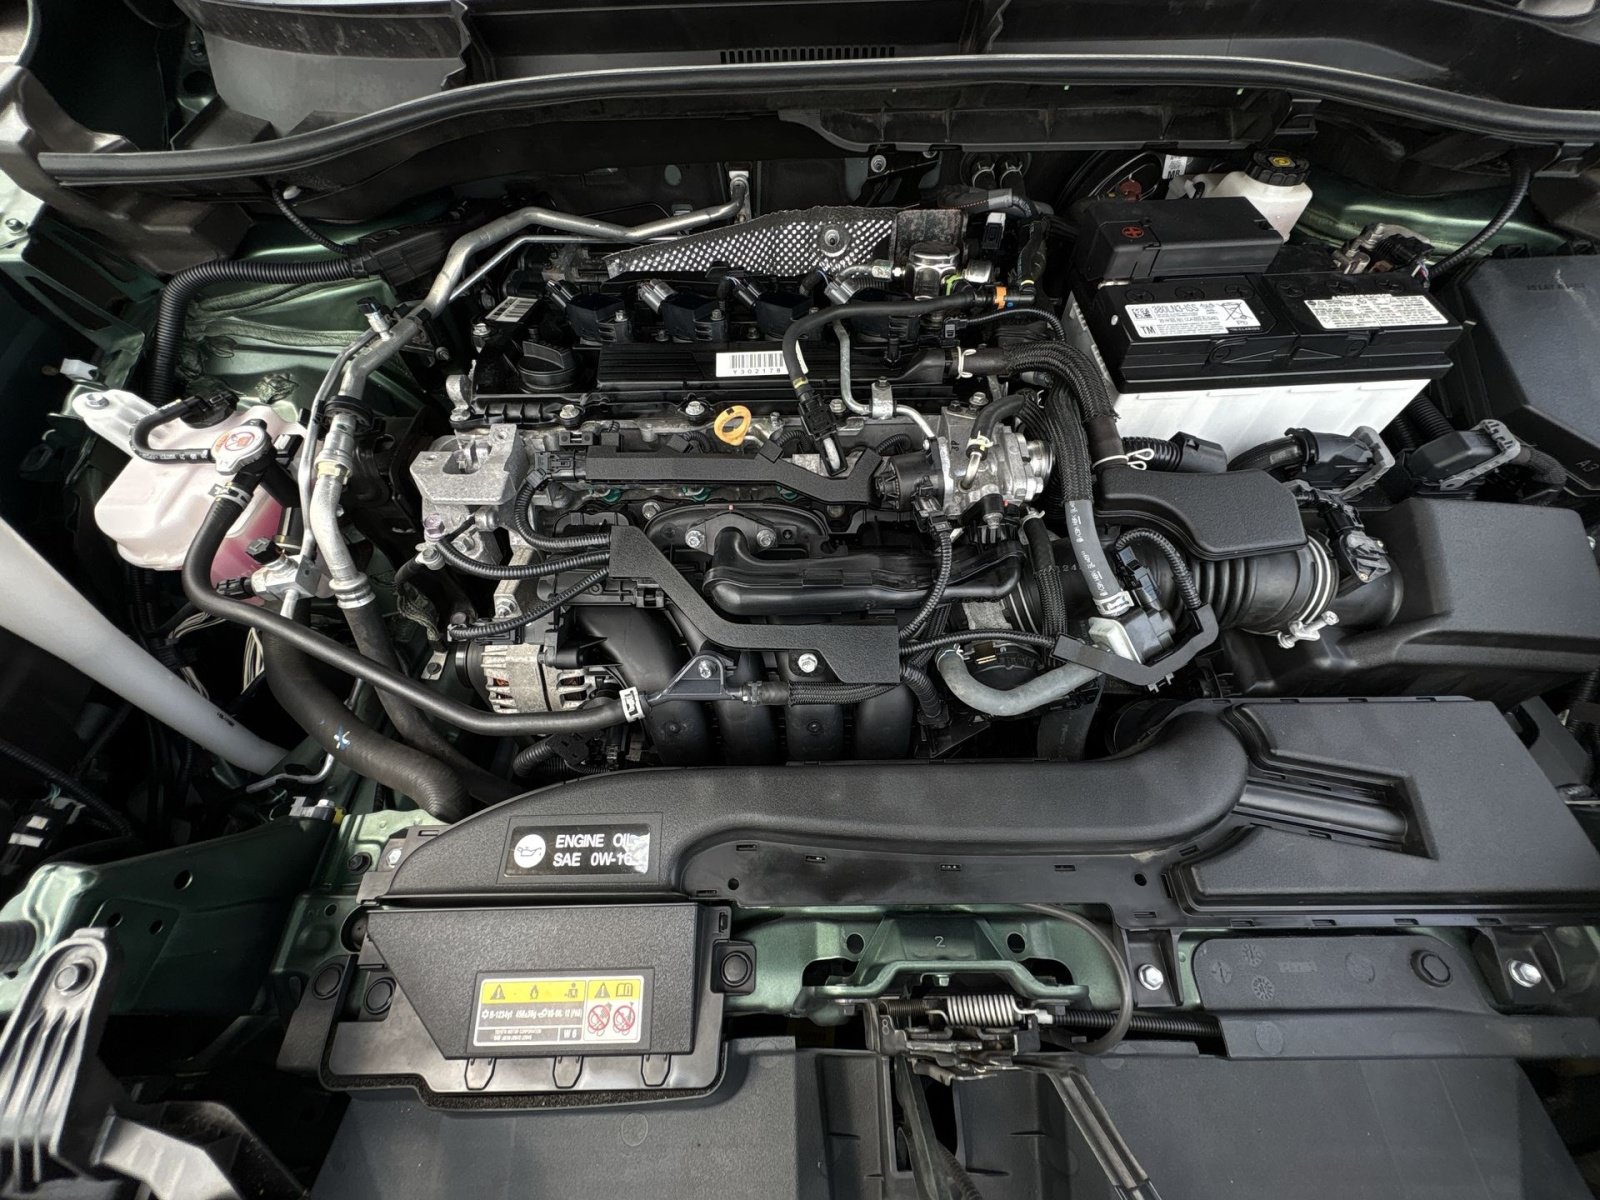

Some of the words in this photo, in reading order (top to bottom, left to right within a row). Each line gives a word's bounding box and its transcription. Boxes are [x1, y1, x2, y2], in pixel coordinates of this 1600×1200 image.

[1152, 303, 1199, 313] 380LN3-ISS
[1141, 326, 1156, 335] TM
[555, 834, 605, 848] ENGINE
[613, 833, 631, 848] OIL
[553, 852, 582, 867] SAE
[590, 852, 633, 866] 0W-16
[934, 935, 946, 948] 2
